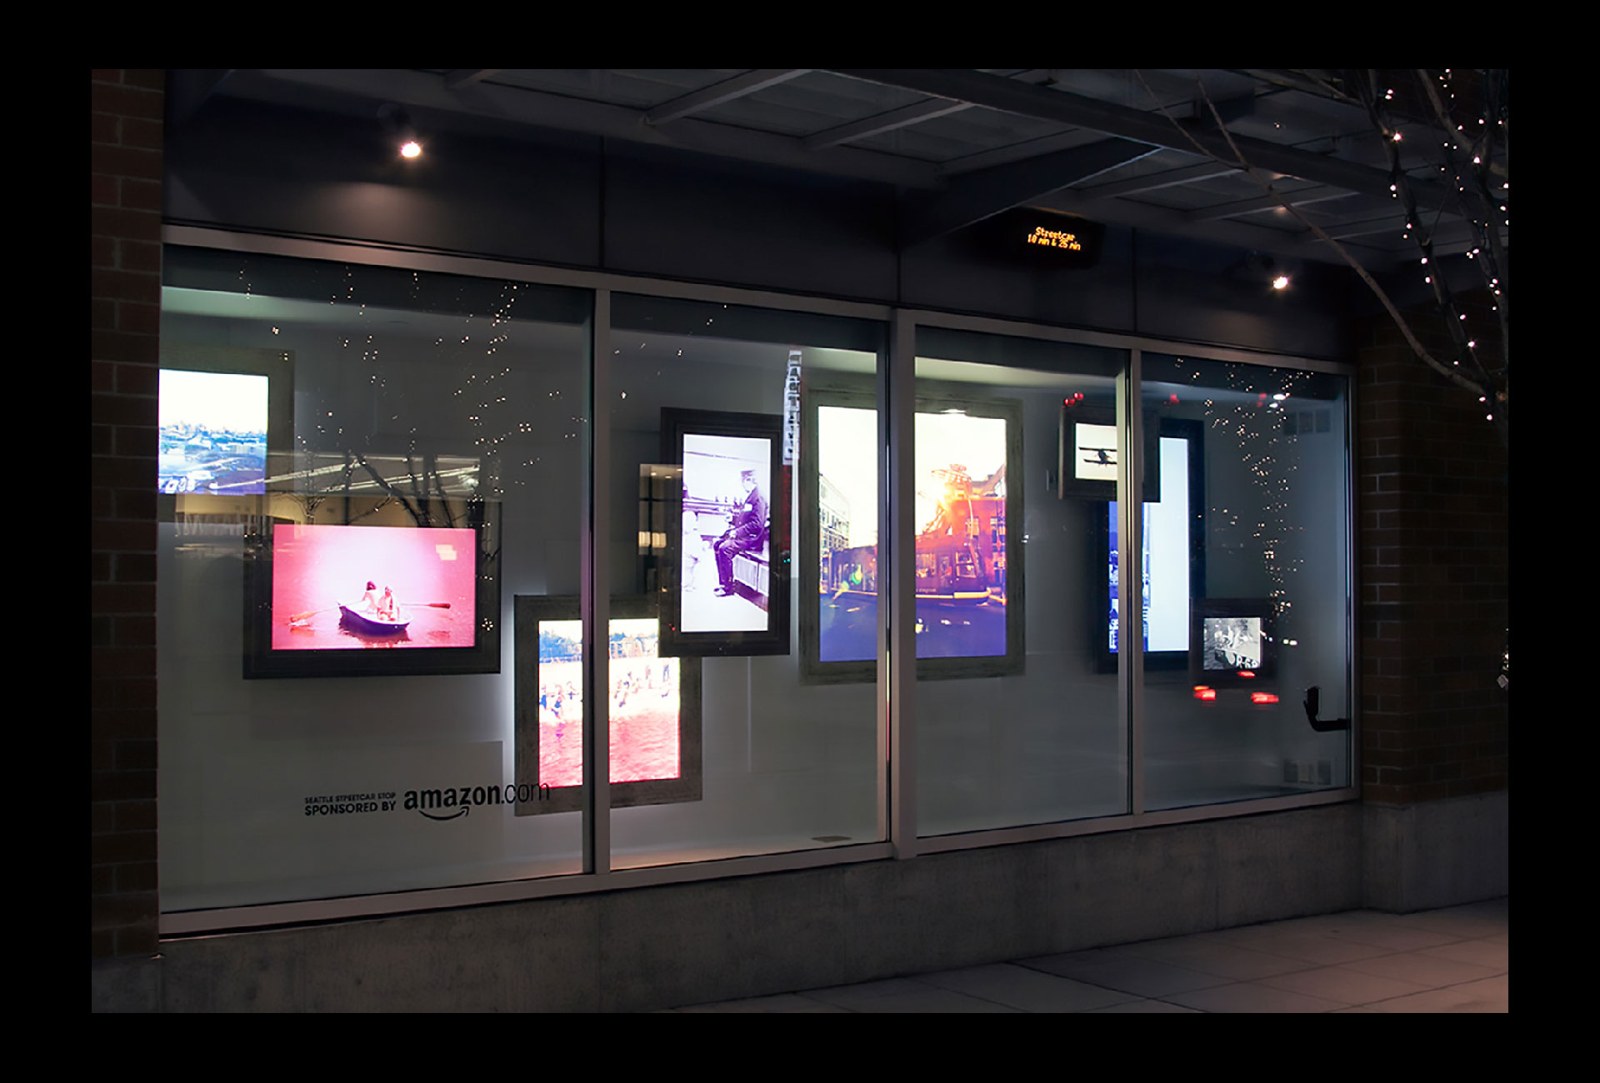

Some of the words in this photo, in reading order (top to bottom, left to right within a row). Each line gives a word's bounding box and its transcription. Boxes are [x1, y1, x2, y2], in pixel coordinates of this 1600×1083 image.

[1035, 226, 1075, 241] Streetcar
[1038, 236, 1050, 246] min
[1058, 238, 1069, 248] 25
[1069, 241, 1081, 251] min
[304, 796, 333, 804] SEATTLE
[335, 793, 376, 802] STREETCAR
[403, 784, 550, 811] amazon.com
[304, 801, 378, 816] SPONSORED
[381, 800, 396, 811] BY
